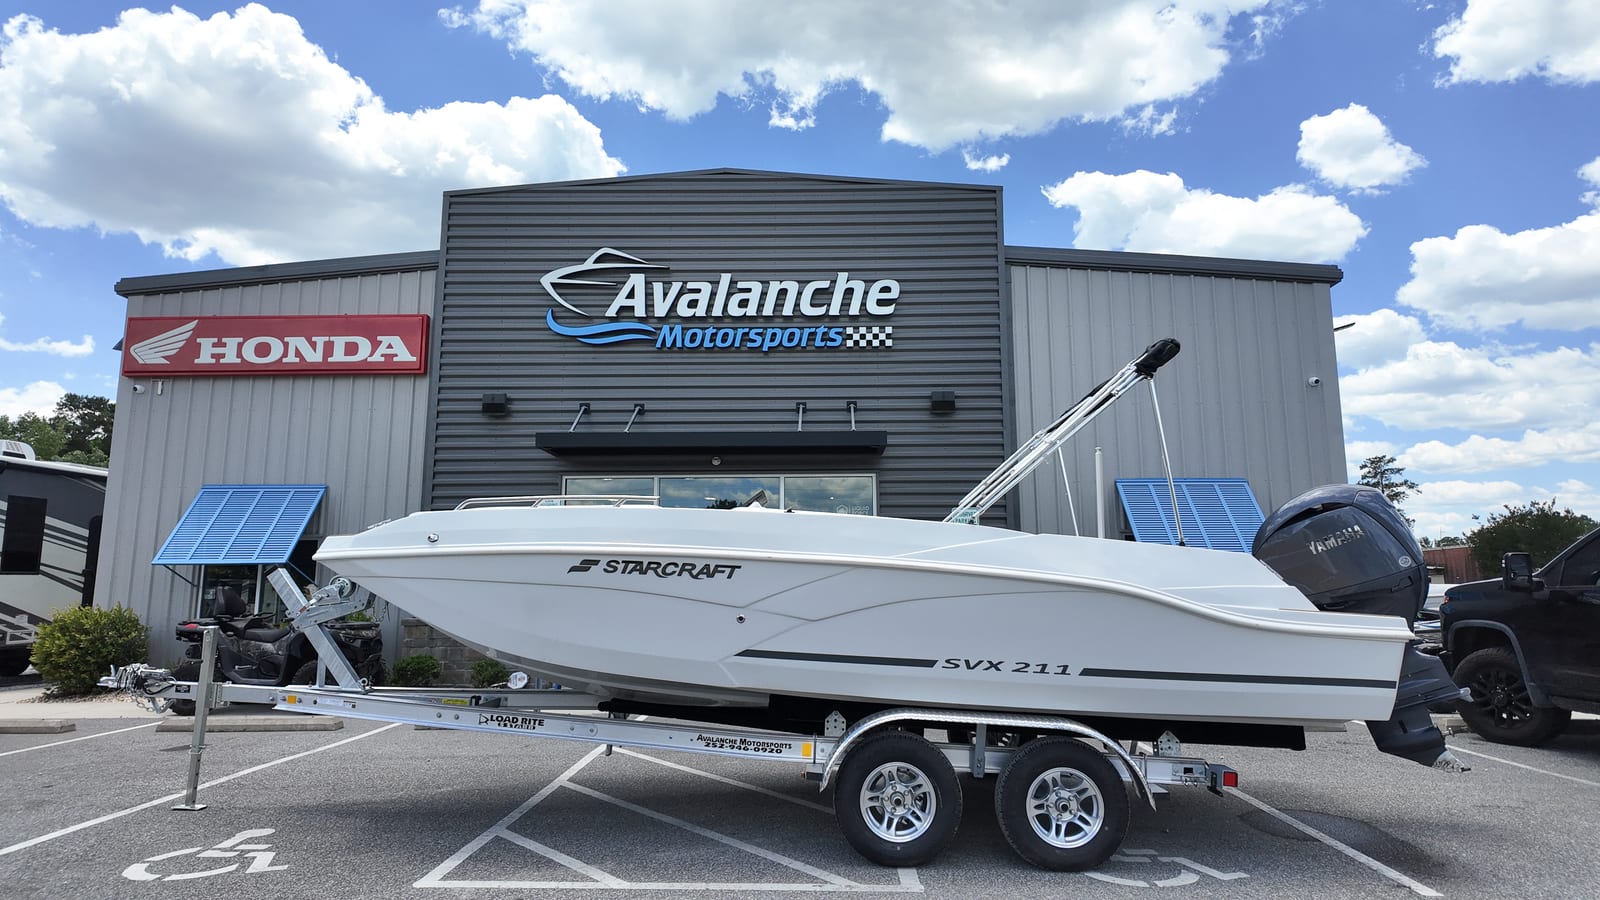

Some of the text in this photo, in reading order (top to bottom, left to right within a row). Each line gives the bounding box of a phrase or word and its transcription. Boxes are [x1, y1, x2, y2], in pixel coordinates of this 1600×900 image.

[604, 272, 900, 318] Avalanche
[194, 335, 417, 364] HONDA
[655, 324, 844, 352] Motorsports
[1306, 524, 1365, 555] YAMAHA
[603, 559, 742, 580] STARCRAFT
[941, 658, 1071, 676] SVX 211
[490, 714, 519, 724] LOAD
[520, 717, 545, 727] RITE
[704, 741, 783, 754] 252-946-0920
